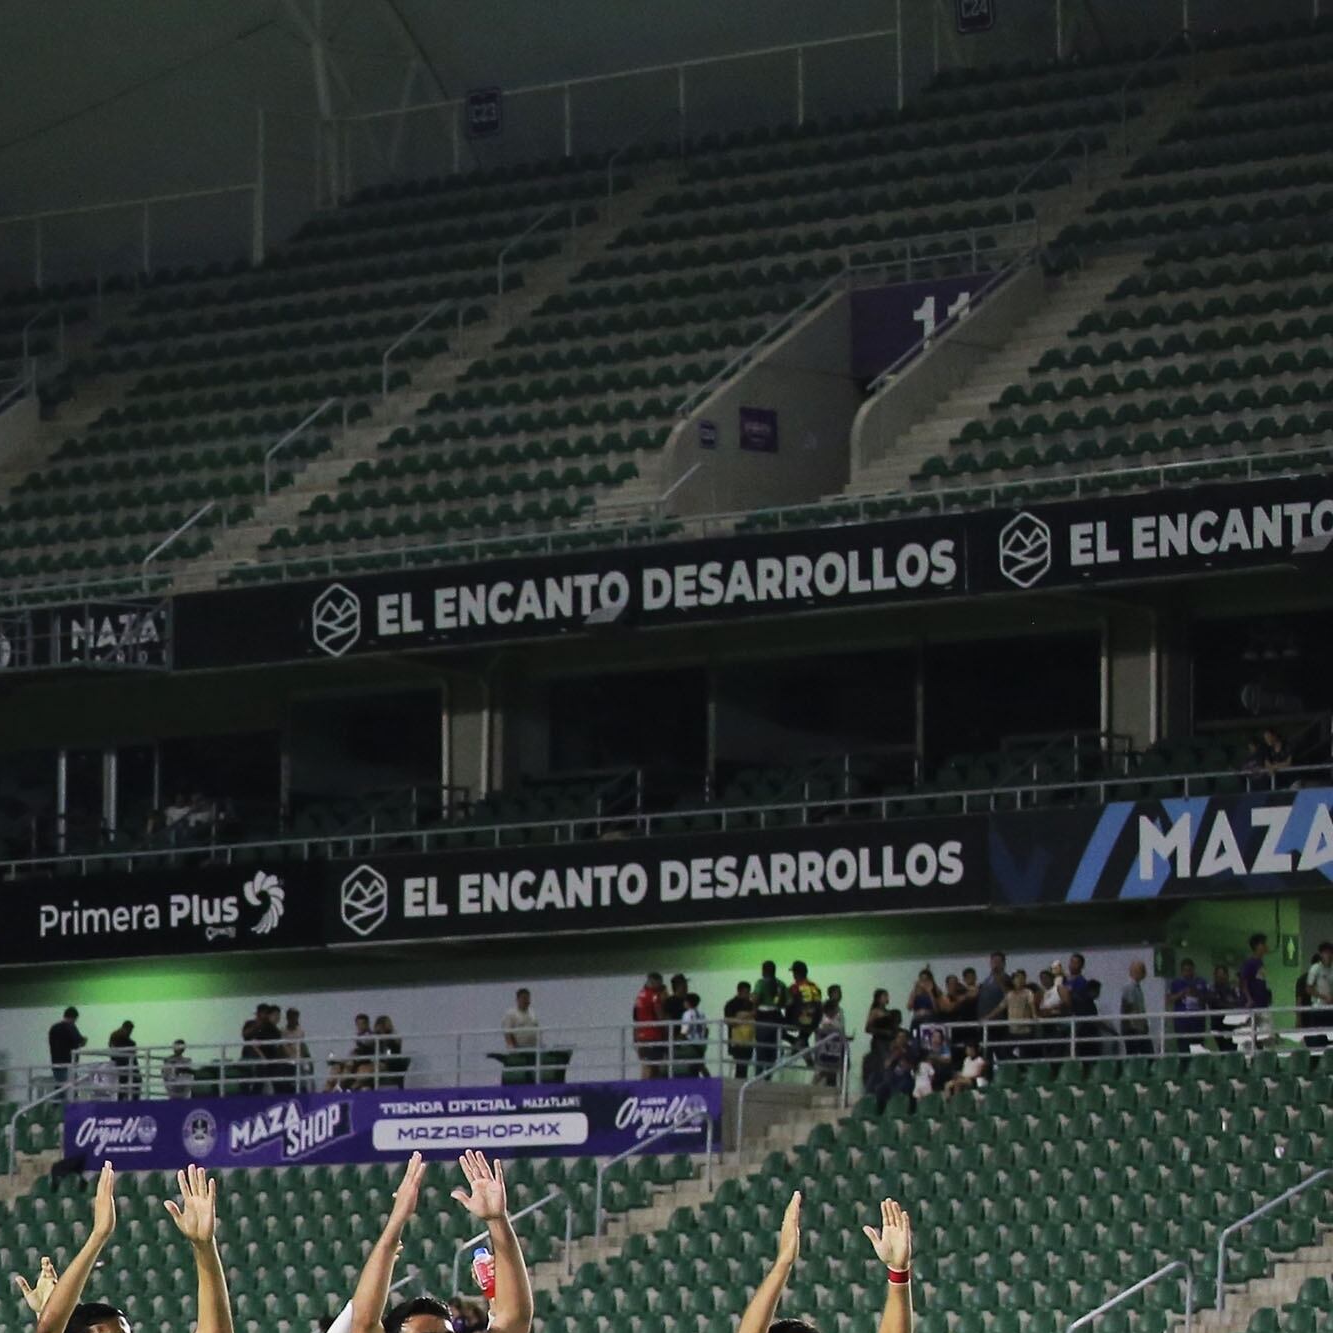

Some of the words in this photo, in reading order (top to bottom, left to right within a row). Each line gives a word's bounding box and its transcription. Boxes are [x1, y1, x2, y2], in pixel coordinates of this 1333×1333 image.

[1070, 521, 1120, 567] EL
[377, 594, 424, 636] EL
[435, 570, 630, 629] ENCANTO
[642, 538, 957, 611] DESARROLLOS
[403, 877, 448, 918] EL
[458, 862, 648, 915] ENCANTO
[660, 840, 964, 901] DESARROLLOS
[39, 900, 161, 937] Primera
[169, 893, 240, 928] Plus
[230, 1102, 303, 1151] MAZA
[286, 1102, 342, 1157] SHOP
[379, 1100, 444, 1115] TIENDA
[447, 1099, 517, 1112] OFICIAL
[397, 1122, 562, 1141] MAZASHOP.MX
